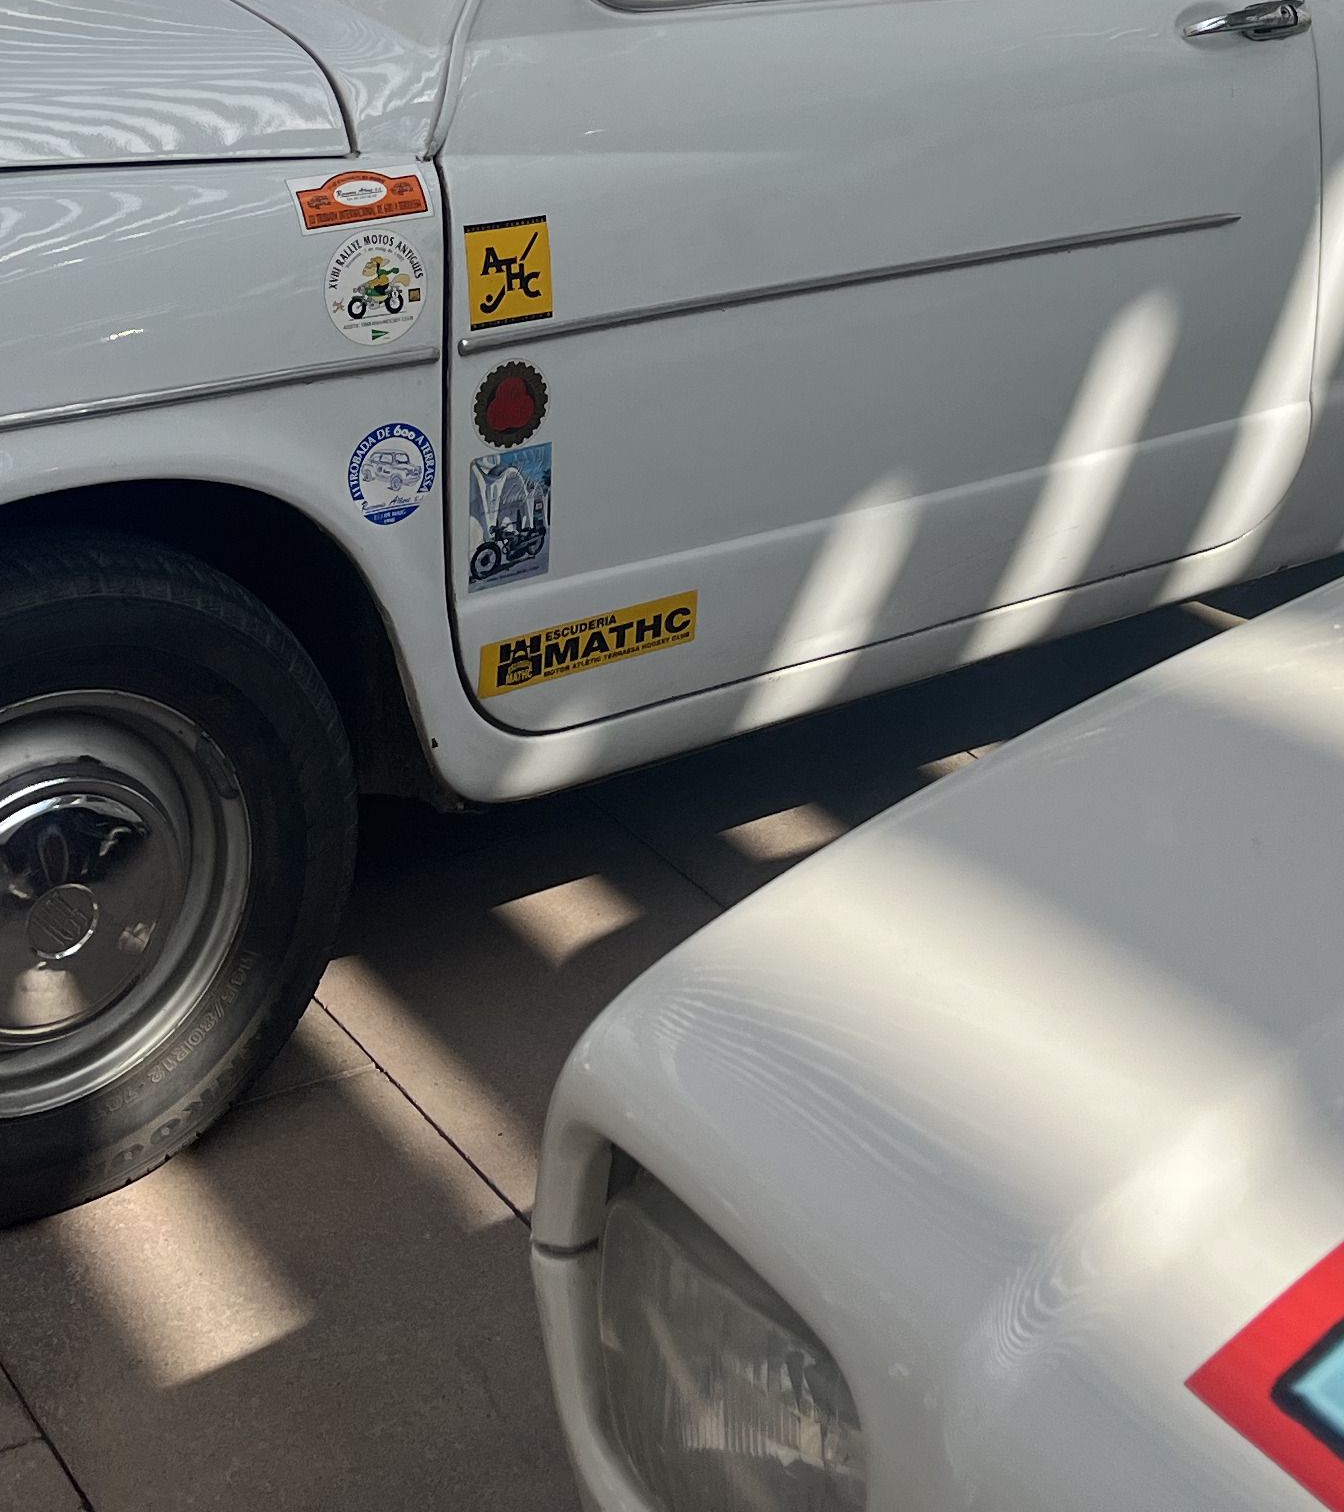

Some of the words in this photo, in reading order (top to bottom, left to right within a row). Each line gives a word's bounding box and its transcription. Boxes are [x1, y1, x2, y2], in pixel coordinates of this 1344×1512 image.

[363, 234, 395, 247] MOTOS
[395, 241, 424, 279] ANTIGUES
[350, 436, 377, 487] TROBADA
[376, 426, 391, 440] DE
[393, 425, 415, 440] 600
[416, 435, 424, 445] A
[421, 442, 435, 492] TERRASSA
[544, 607, 691, 669] MATHC
[546, 614, 617, 642] ESCUDERIA
[544, 666, 570, 678] MOTOR
[603, 645, 640, 660] TERRASSA
[642, 637, 670, 650] HOCKEY
[672, 631, 690, 642] CLUB
